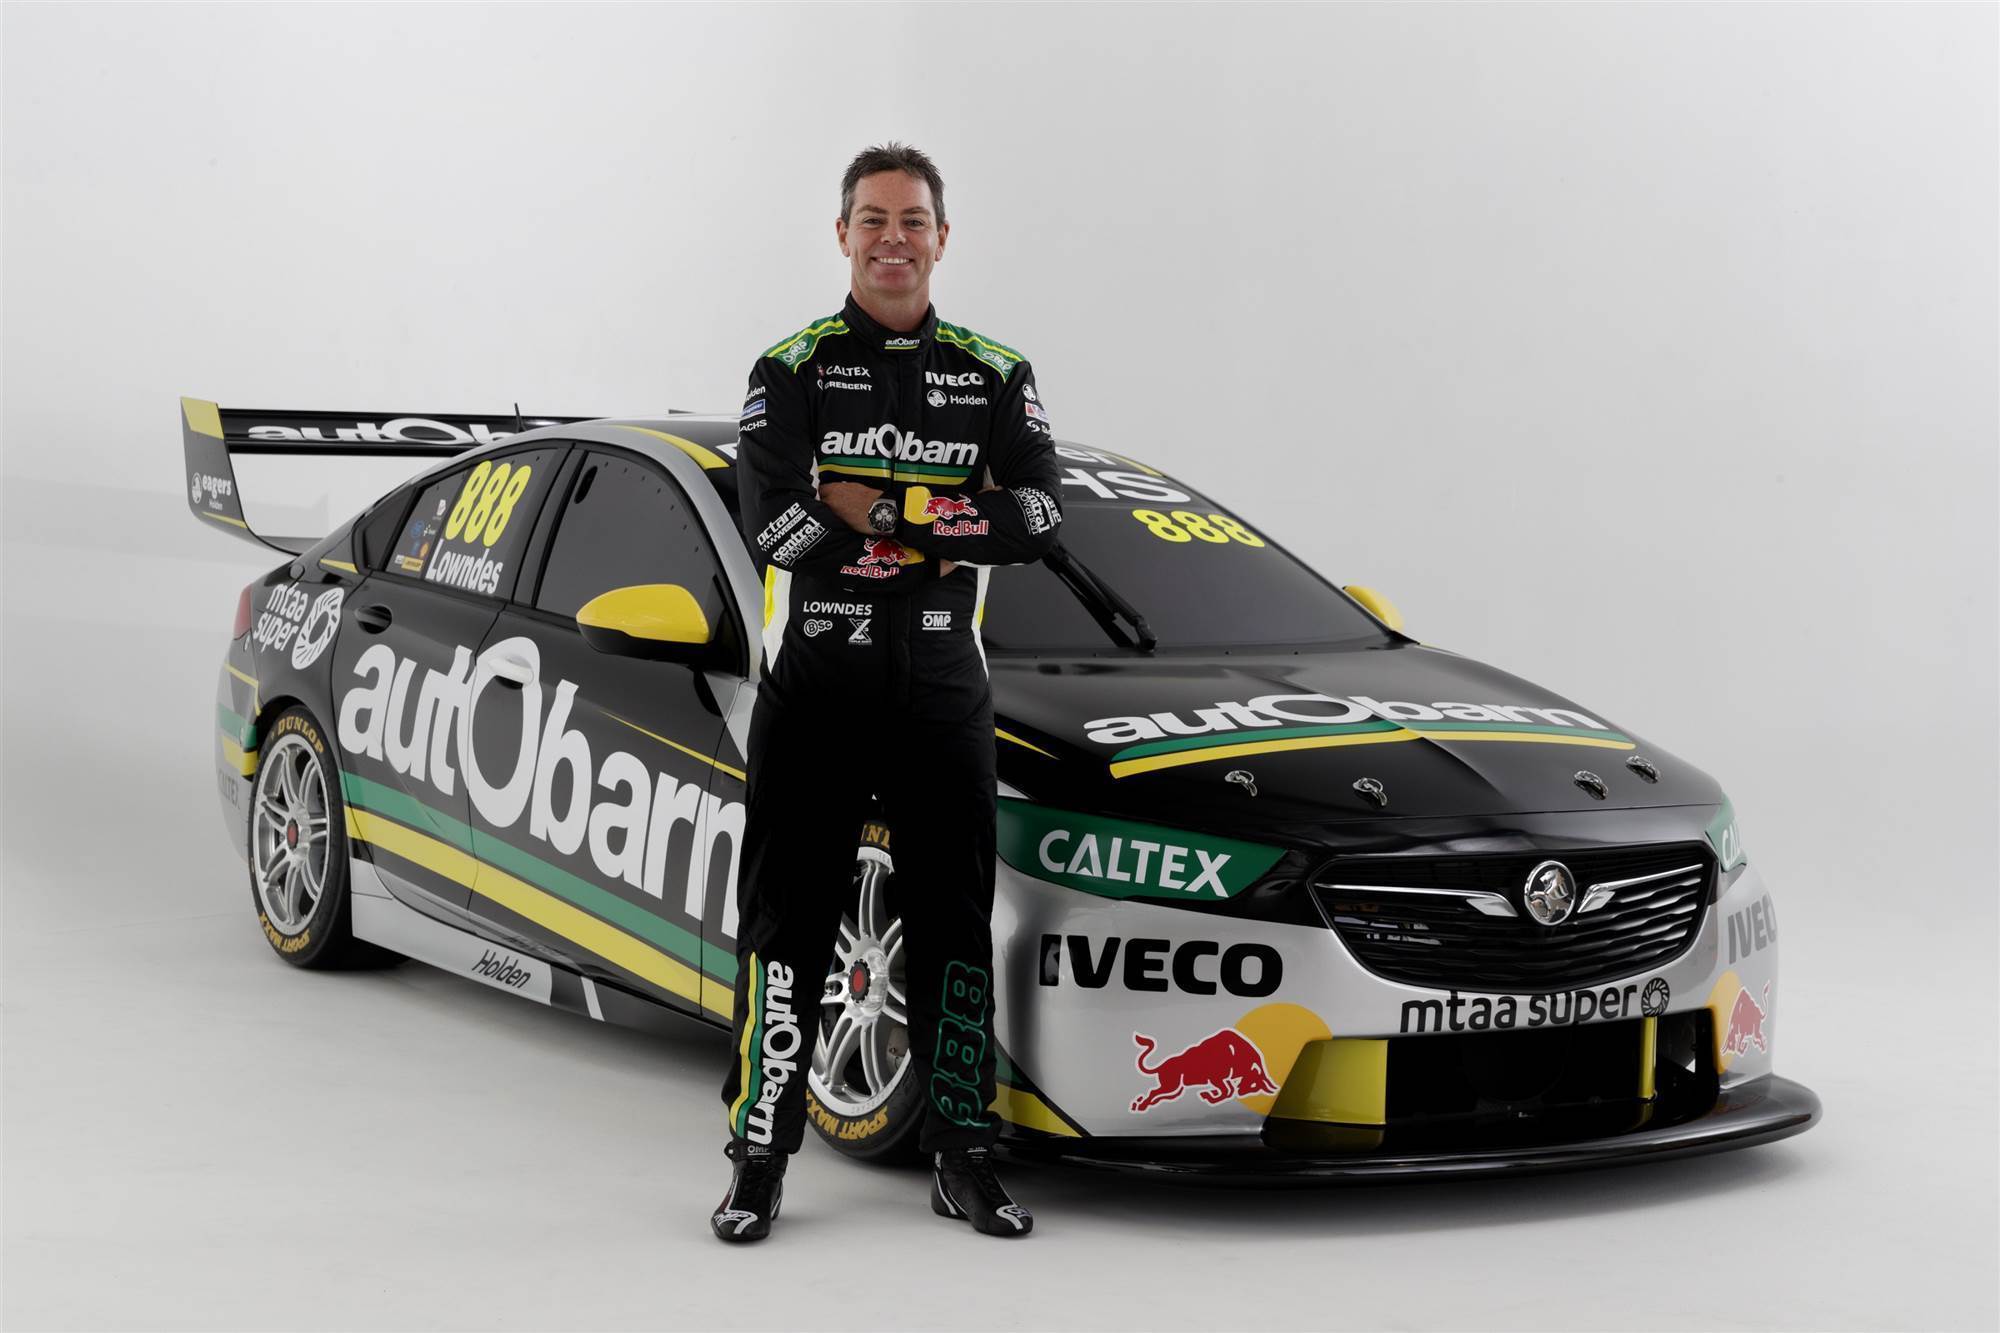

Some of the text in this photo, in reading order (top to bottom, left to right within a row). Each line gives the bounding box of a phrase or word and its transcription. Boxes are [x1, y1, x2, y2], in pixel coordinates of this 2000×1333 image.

[824, 380, 873, 392] CRESCENT
[826, 365, 871, 378] CALTEX
[925, 371, 985, 386] IVECO
[950, 394, 988, 406] Holden
[740, 419, 768, 433] ACHS
[202, 474, 232, 500] eagers
[445, 460, 532, 547] 888
[757, 502, 802, 546] octane
[772, 515, 821, 562] central
[933, 520, 989, 536] Red Bull
[1132, 509, 1265, 547] 888
[425, 538, 504, 594] Lowndes
[266, 582, 308, 622] mtaa
[803, 601, 872, 616] LOWNDES
[923, 614, 952, 628] OMP
[252, 612, 299, 653] super
[277, 715, 324, 754] DUNLOP
[1038, 829, 1231, 898] CALTEX
[471, 949, 531, 989] Holden
[1039, 934, 1283, 998] IVECO
[1400, 984, 1637, 1034] mtaa super
[931, 960, 991, 1128] 888
[838, 1105, 889, 1140] SPORT
